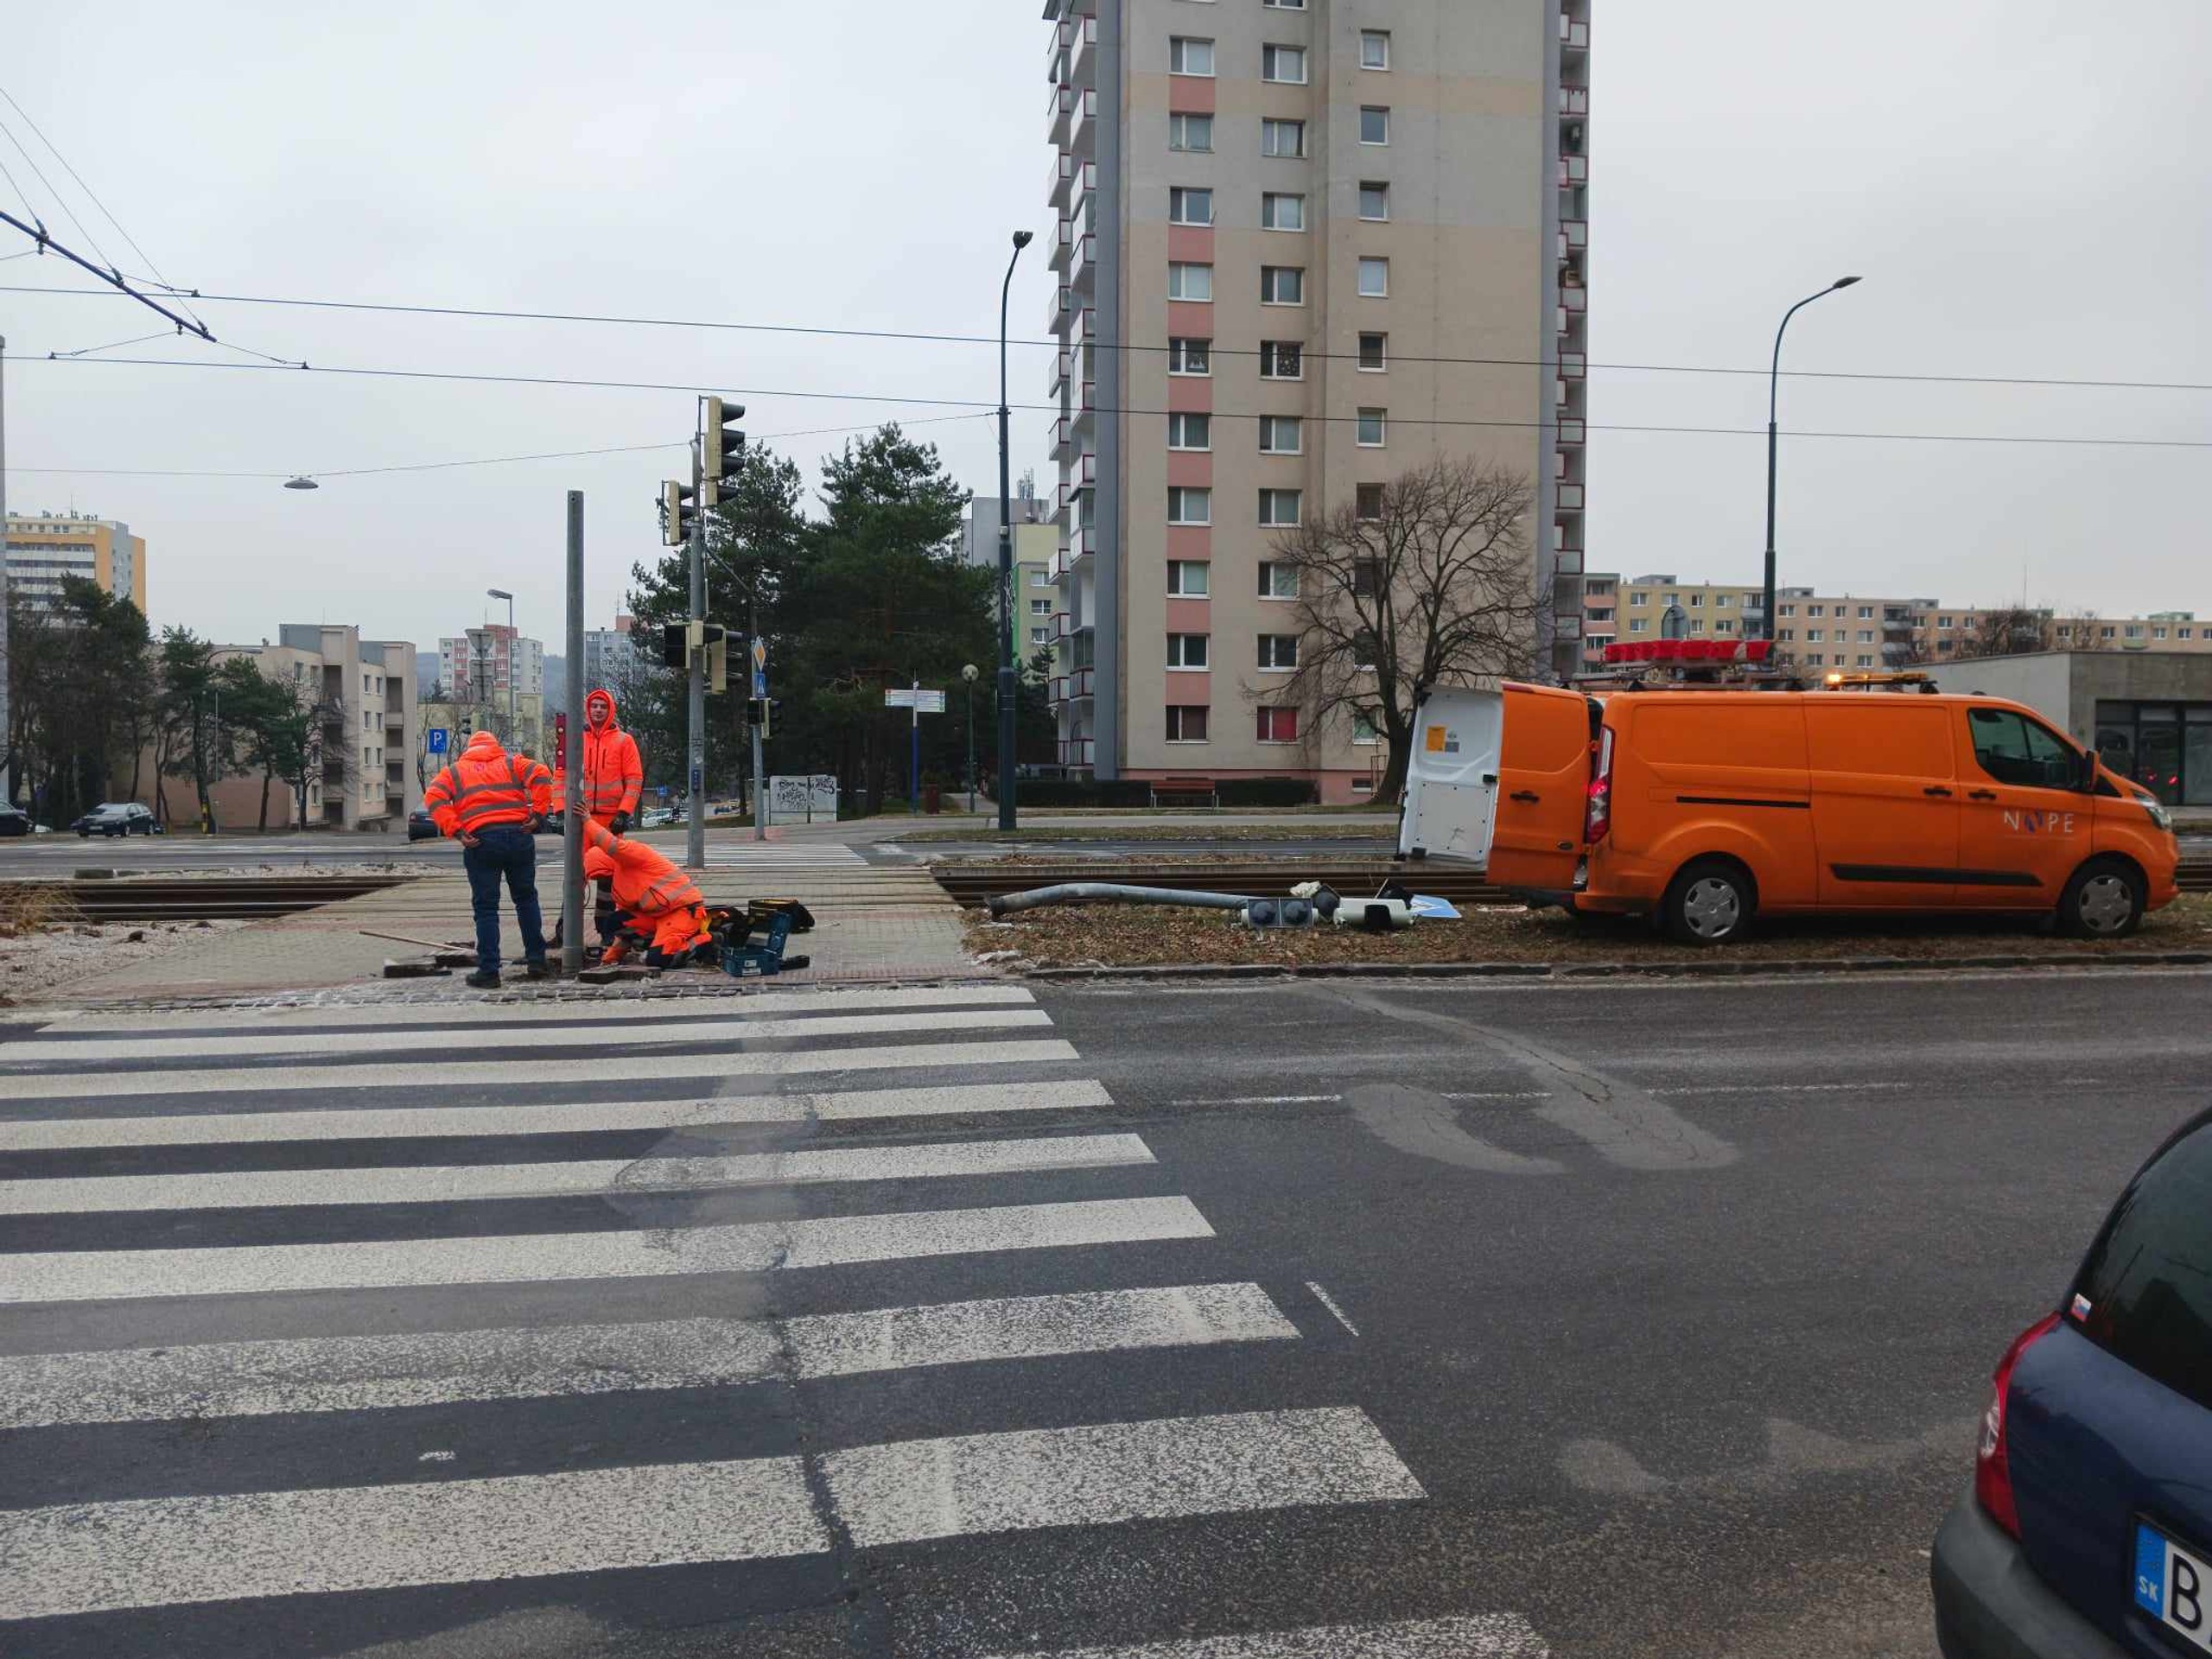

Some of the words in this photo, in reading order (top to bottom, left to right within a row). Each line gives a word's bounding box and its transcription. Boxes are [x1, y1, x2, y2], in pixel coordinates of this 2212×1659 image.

[433, 732, 442, 746] P
[2004, 810, 2074, 833] NOPE
[2138, 1575, 2158, 1602] SK
[2171, 1553, 2212, 1640] B
